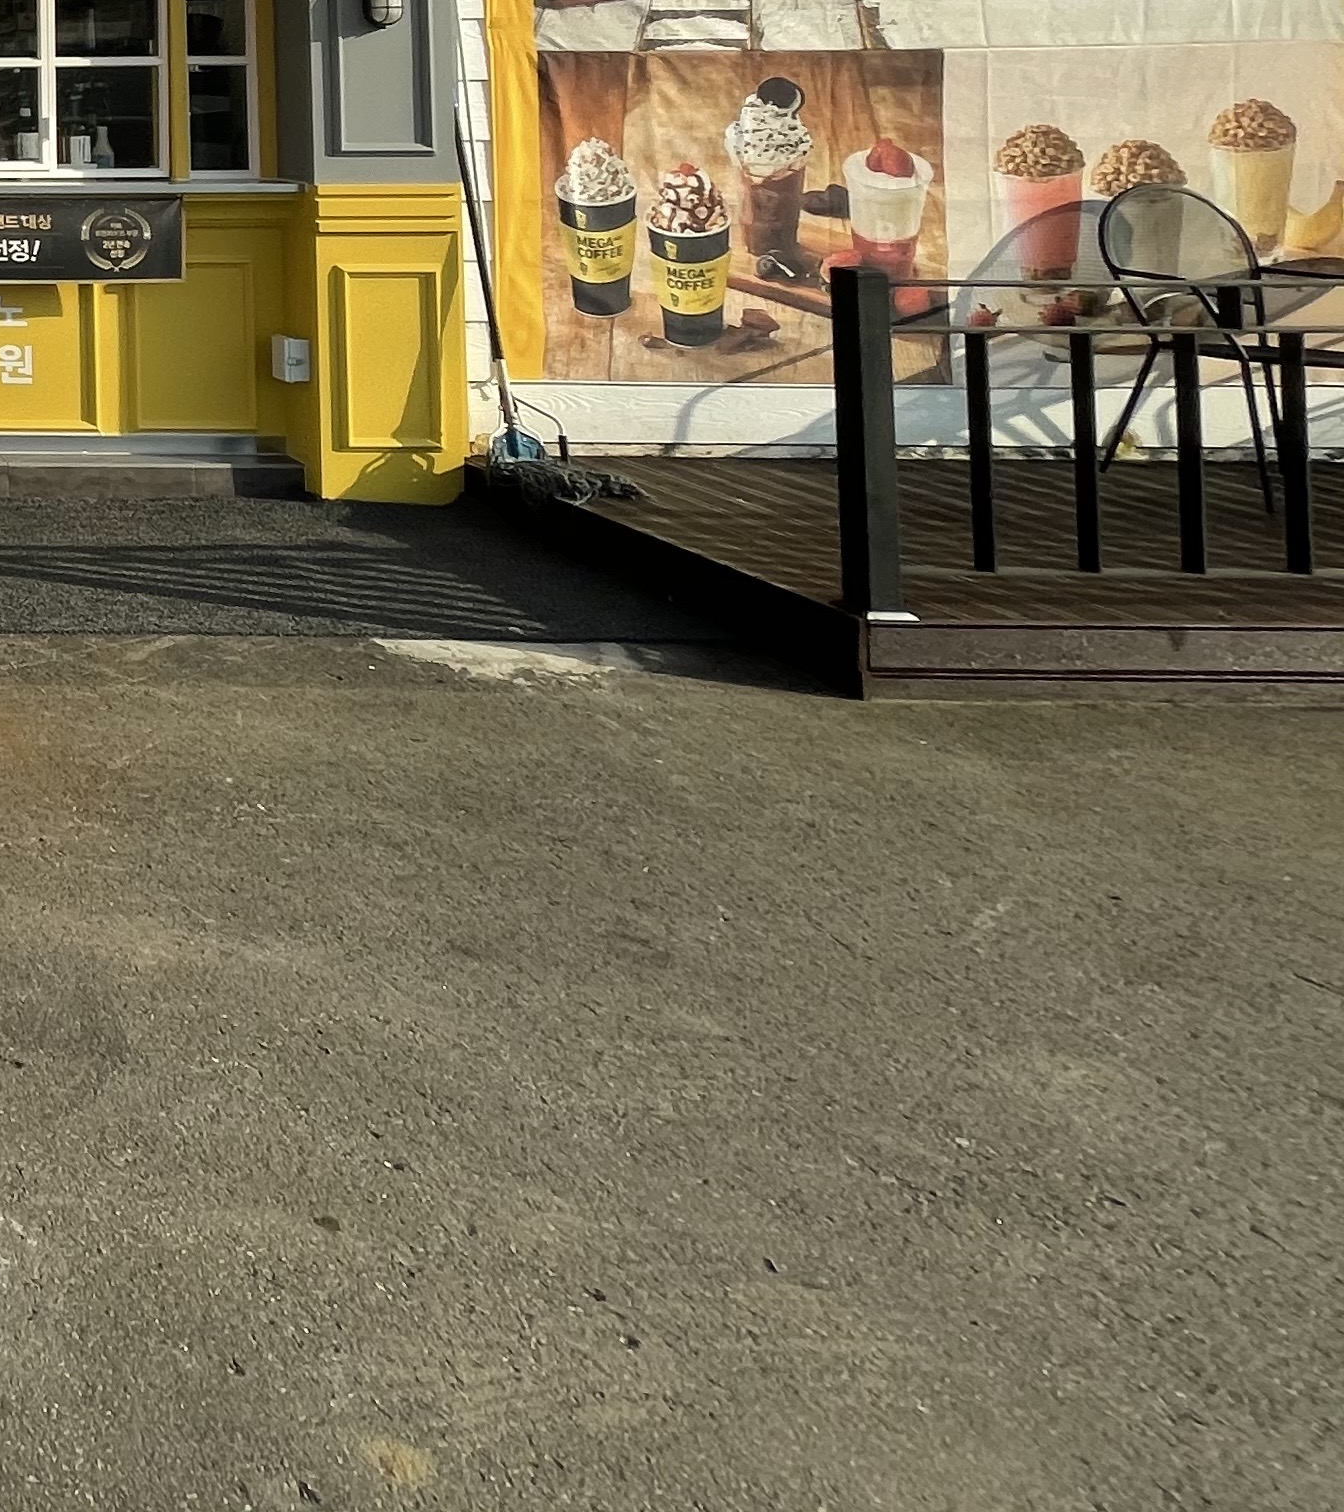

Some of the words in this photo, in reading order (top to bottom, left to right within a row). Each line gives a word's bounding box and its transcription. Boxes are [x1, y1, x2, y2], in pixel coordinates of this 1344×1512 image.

[22, 214, 52, 231] 대상
[577, 235, 614, 248] MEGA
[577, 245, 624, 260] COFFEE
[667, 267, 706, 280] MEGA
[666, 277, 716, 291] COFFEE
